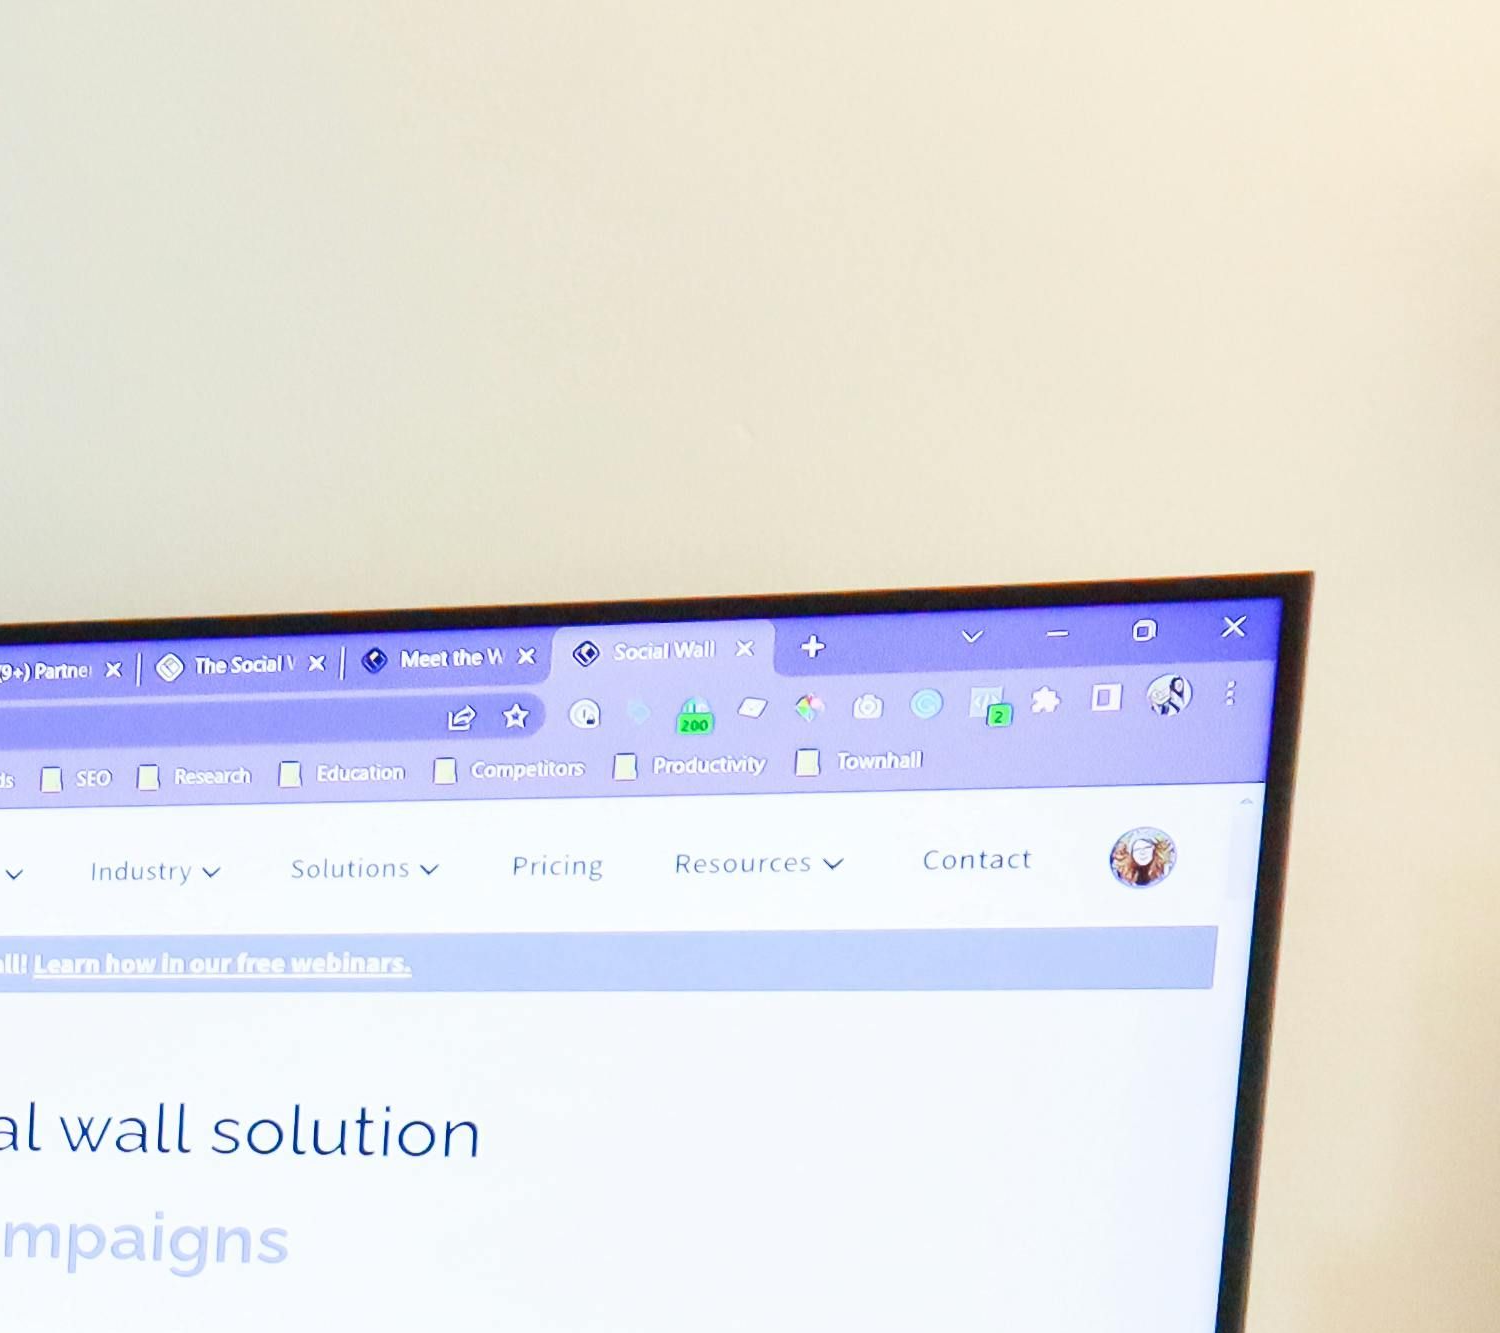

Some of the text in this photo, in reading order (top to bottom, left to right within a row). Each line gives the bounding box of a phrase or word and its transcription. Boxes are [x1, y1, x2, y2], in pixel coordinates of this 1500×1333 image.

[401, 650, 449, 668] Meet
[452, 649, 484, 666] the
[613, 640, 716, 661] Social Wall
[195, 657, 228, 674] The
[230, 656, 283, 674] Social
[681, 718, 709, 733] 200
[994, 711, 1004, 724] 2
[471, 760, 586, 782] Competitors
[653, 755, 767, 777] Productivity
[837, 751, 924, 771] Townhall
[76, 771, 113, 788] SEO
[174, 767, 251, 786] Research
[317, 764, 406, 783] Education
[290, 857, 410, 880] Solutions
[512, 855, 604, 881] Pricing
[675, 853, 813, 875] Resources
[923, 848, 1033, 871] Contact
[91, 861, 193, 886] Industry
[33, 954, 101, 978] Learn
[105, 954, 157, 977] how
[160, 953, 185, 976] in
[190, 957, 232, 976] our
[236, 952, 285, 976] free
[290, 952, 412, 976] webinars.
[59, 1103, 192, 1155] wall
[210, 1104, 481, 1158] solution
